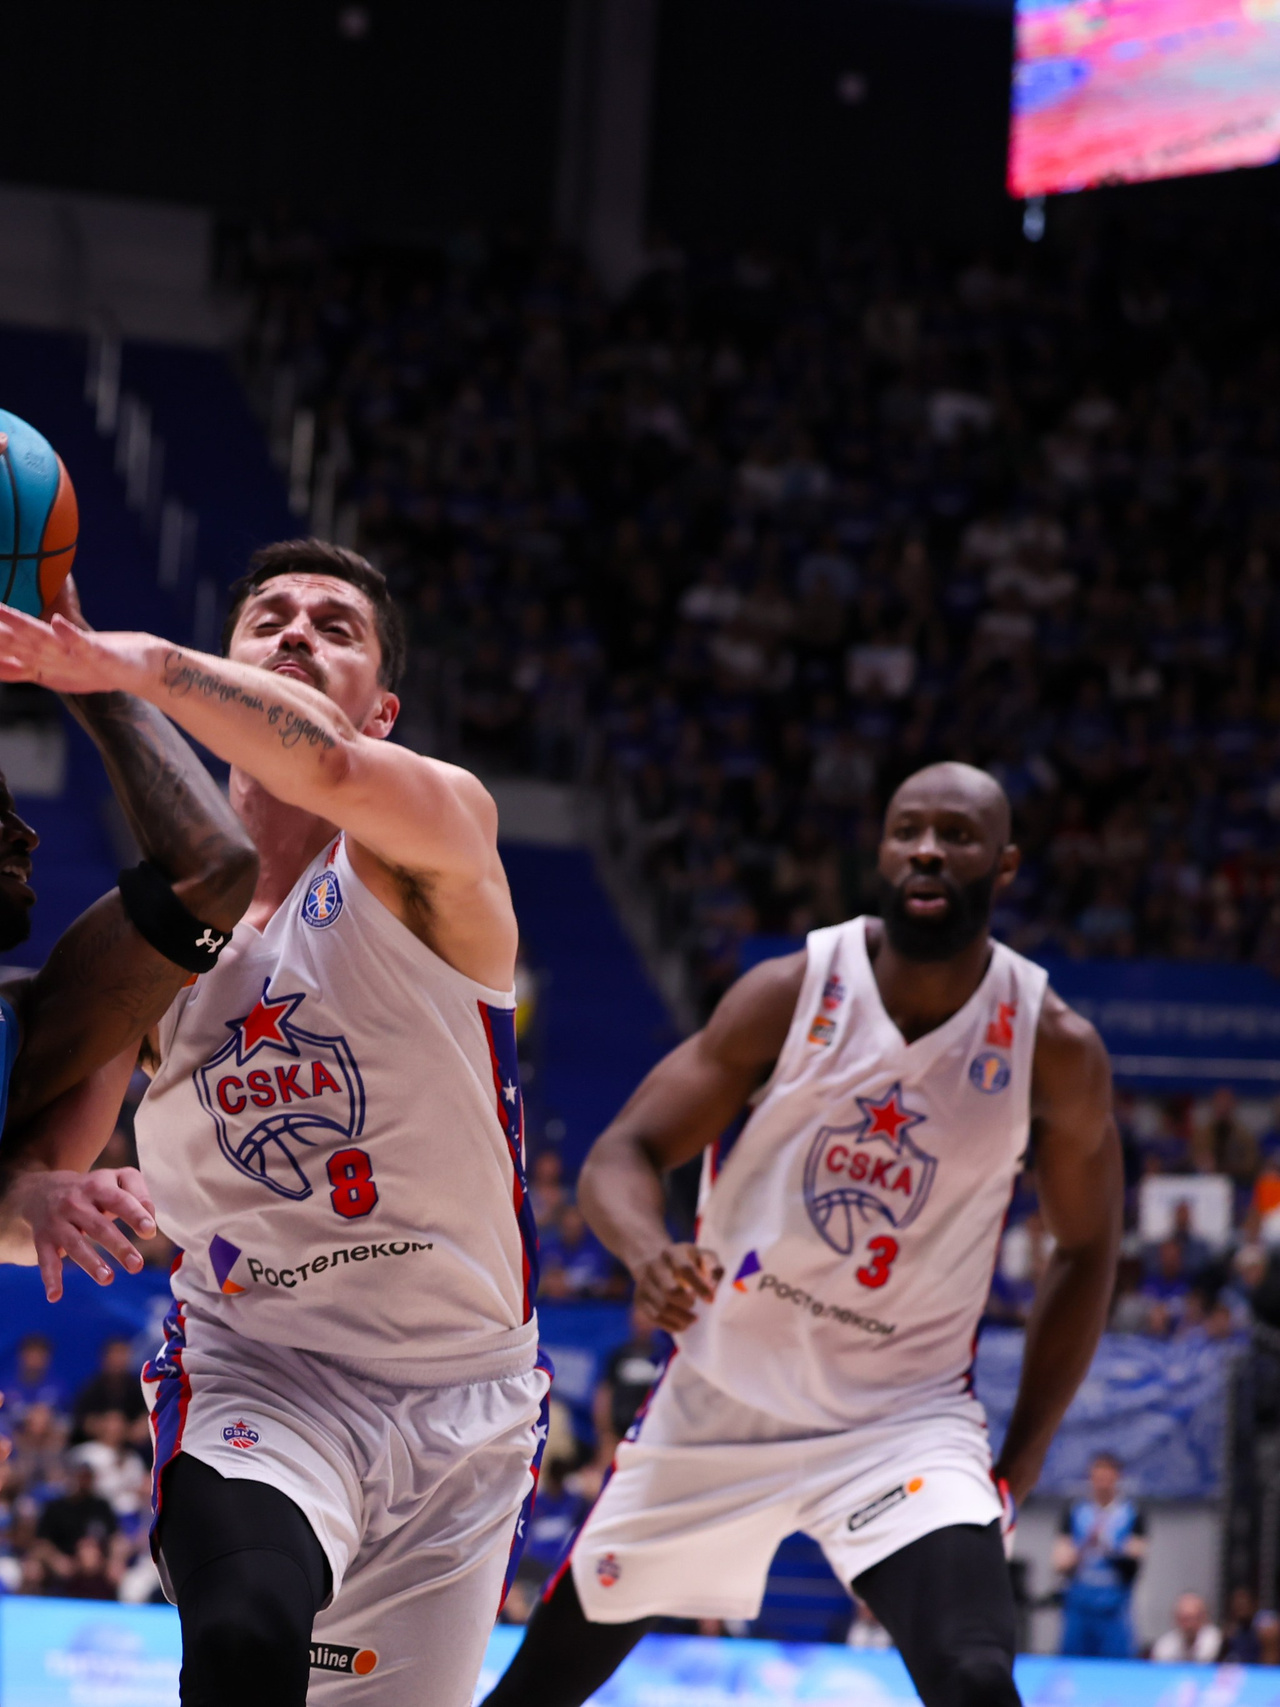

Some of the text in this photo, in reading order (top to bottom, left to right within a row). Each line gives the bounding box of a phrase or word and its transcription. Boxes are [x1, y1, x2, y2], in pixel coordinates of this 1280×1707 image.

[216, 1060, 342, 1115] CSKA
[326, 1148, 379, 1220] 8
[825, 1144, 913, 1197] CSKA
[247, 1241, 434, 1288] Ростелеком
[856, 1236, 899, 1289] 3
